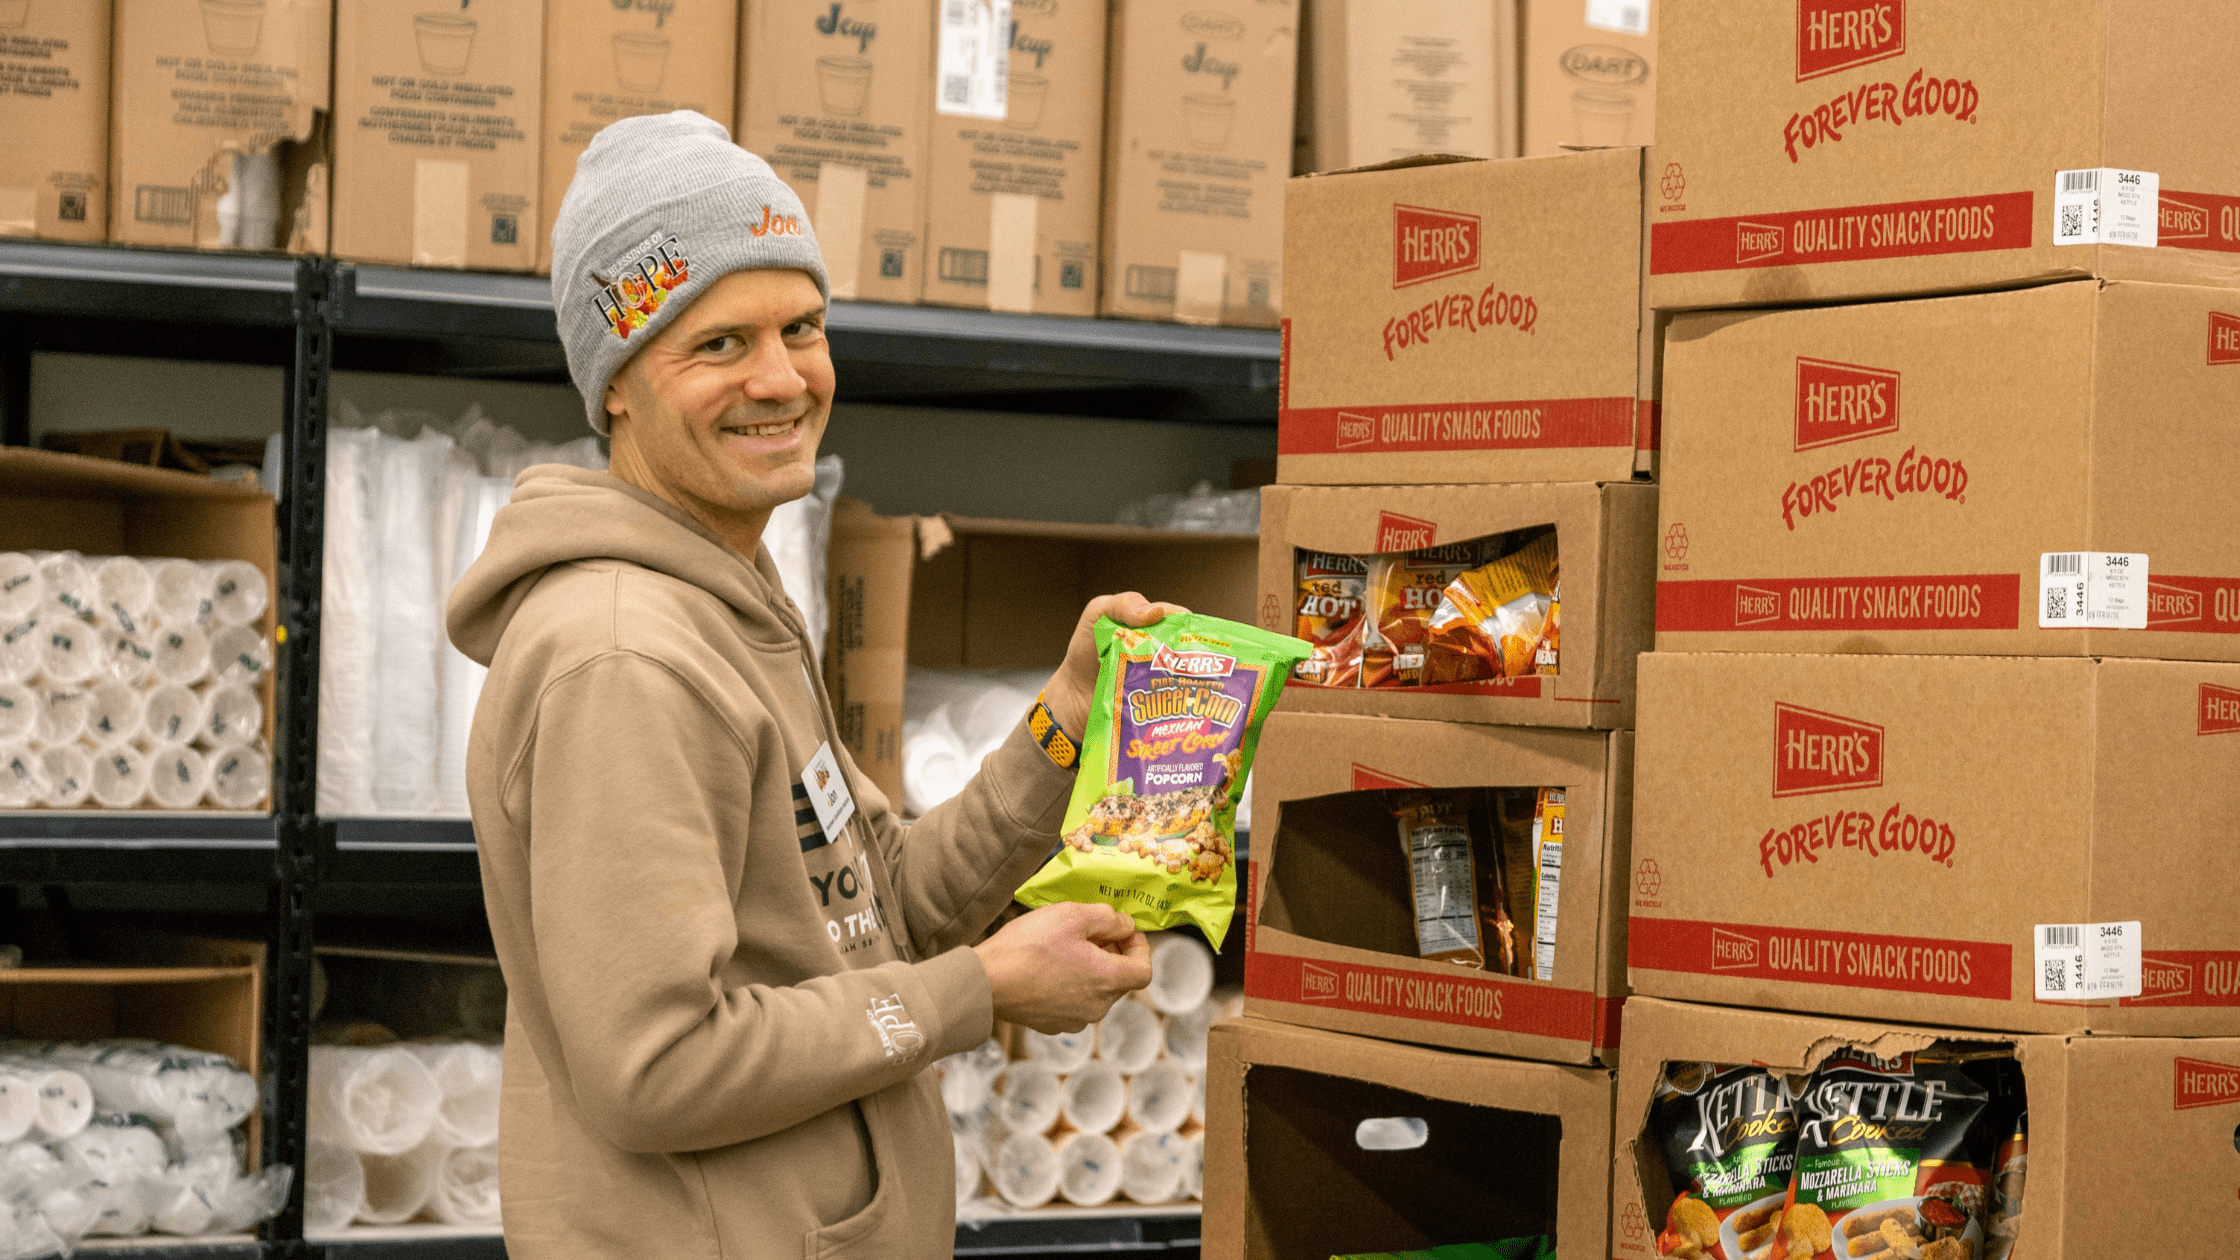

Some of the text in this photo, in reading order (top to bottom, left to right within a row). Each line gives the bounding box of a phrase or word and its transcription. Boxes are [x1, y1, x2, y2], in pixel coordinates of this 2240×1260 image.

[1807, 3, 1892, 50] HERR'S
[1784, 67, 1979, 163] FOREVER GOOD
[2118, 173, 2140, 185] 3446
[751, 206, 801, 237] Jon
[1741, 205, 1994, 253] HERR'S QUALITY SNACK FOODS
[607, 231, 663, 277] BLESSINGS OF
[1403, 223, 1470, 264] HERR'S
[593, 237, 689, 328] HOPE
[1383, 282, 1537, 361] FOREVER GOOD
[2217, 327, 2240, 350] HE
[1805, 380, 1886, 424] HERR'S
[1341, 408, 1541, 443] HERR'S QUALITY SNACK FOODS
[1781, 445, 1968, 531] FOREVER GOOD
[1383, 527, 1429, 552] HERR'S
[1416, 571, 1446, 584] red
[2106, 556, 2129, 567] 3446
[1312, 581, 1342, 594] red
[1404, 588, 1444, 609] HO
[1740, 584, 1981, 620] HERR'S QUALITY SNACK FOODS
[2076, 582, 2084, 617] 3446
[1301, 596, 1357, 619] HOT
[2215, 587, 2240, 622] QU
[1164, 653, 1226, 674] HERR'S
[1295, 661, 1326, 674] EAT
[1535, 649, 1557, 665] HEAT
[2206, 697, 2240, 723] HER
[1152, 720, 1204, 737] MEXICAN
[1147, 763, 1203, 772] ARTIFICIALLY FLAVORED
[1785, 730, 1870, 776] HERR'S
[1145, 772, 1202, 784] POPCORN
[1759, 802, 1956, 878] FOREVER GOOD
[2100, 926, 2123, 937] 3446
[1717, 936, 1971, 985] HERR'S QUALITY SNACK FOODS
[2075, 955, 2083, 989] 3446
[1305, 971, 1503, 1020] HERR'S QUALITY SNACK FOODS
[870, 993, 924, 1060] OPE
[2183, 1071, 2239, 1097] HERR'S
[1686, 1073, 1793, 1157] KETTL
[1724, 1109, 1797, 1150] Cooke
[1801, 1080, 1946, 1148] KETTLE
[1829, 1115, 1933, 1146] Cooked
[1754, 1153, 1793, 1175] STICKS
[1801, 1160, 1911, 1190] MOZZARELLA STICKS
[1817, 1180, 1877, 1202] & MARINARA
